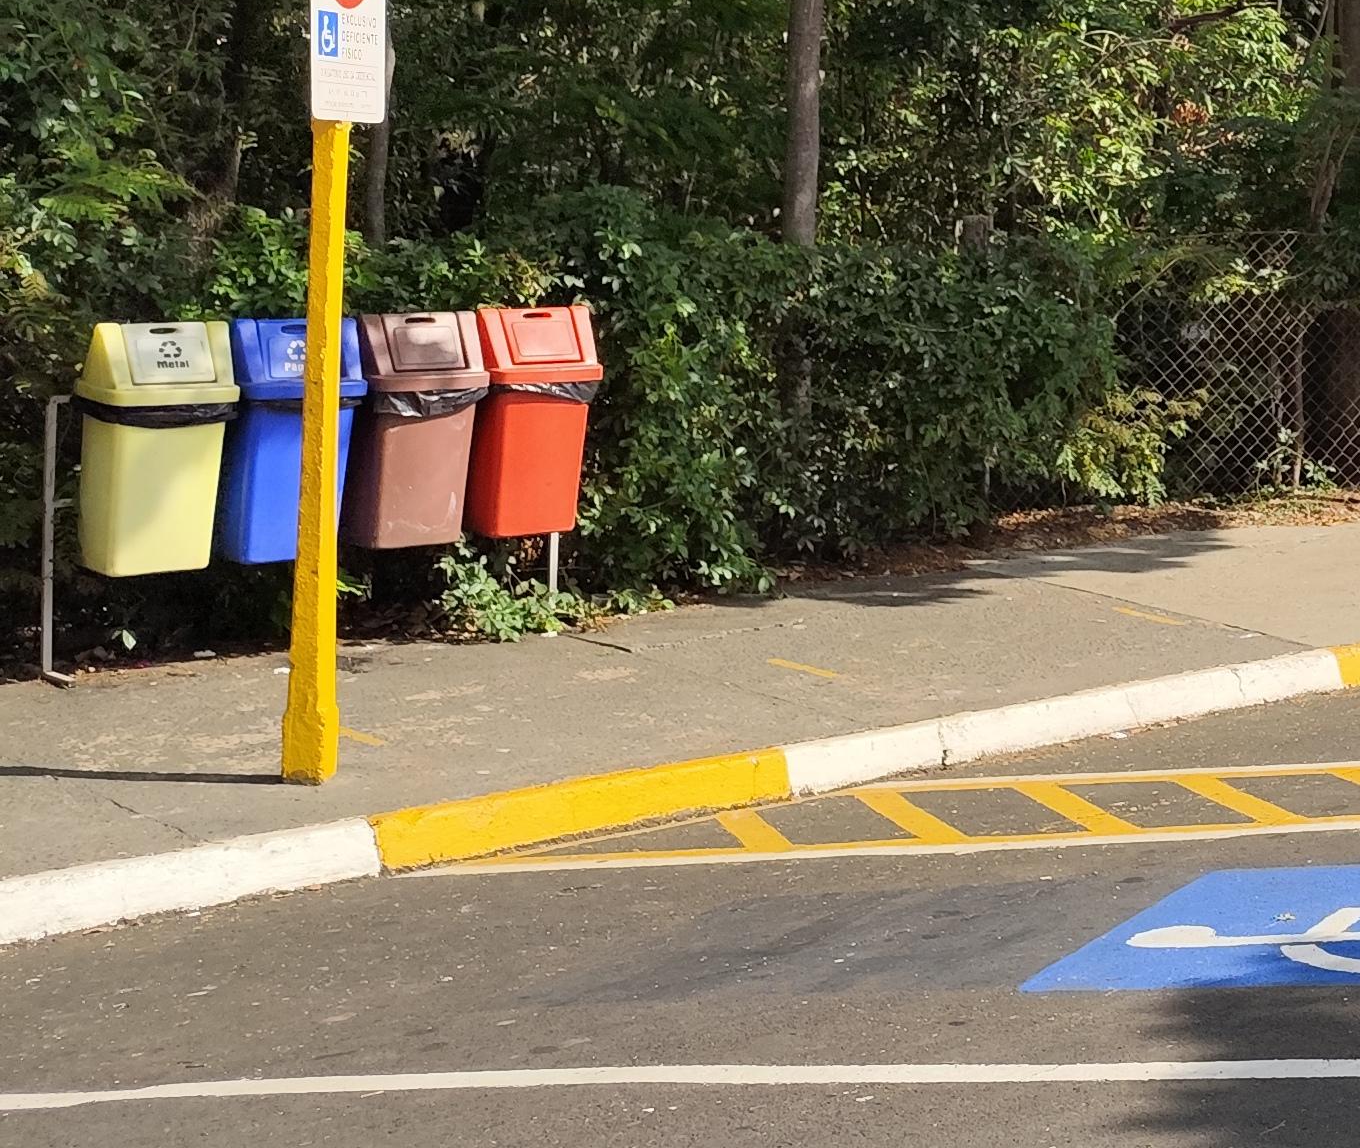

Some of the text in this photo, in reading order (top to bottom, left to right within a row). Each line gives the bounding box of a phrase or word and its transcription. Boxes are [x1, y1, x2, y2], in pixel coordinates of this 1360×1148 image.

[341, 13, 377, 28] EXCLUSIVO
[341, 30, 378, 46] DEFICIENTE
[156, 360, 190, 369] Metal
